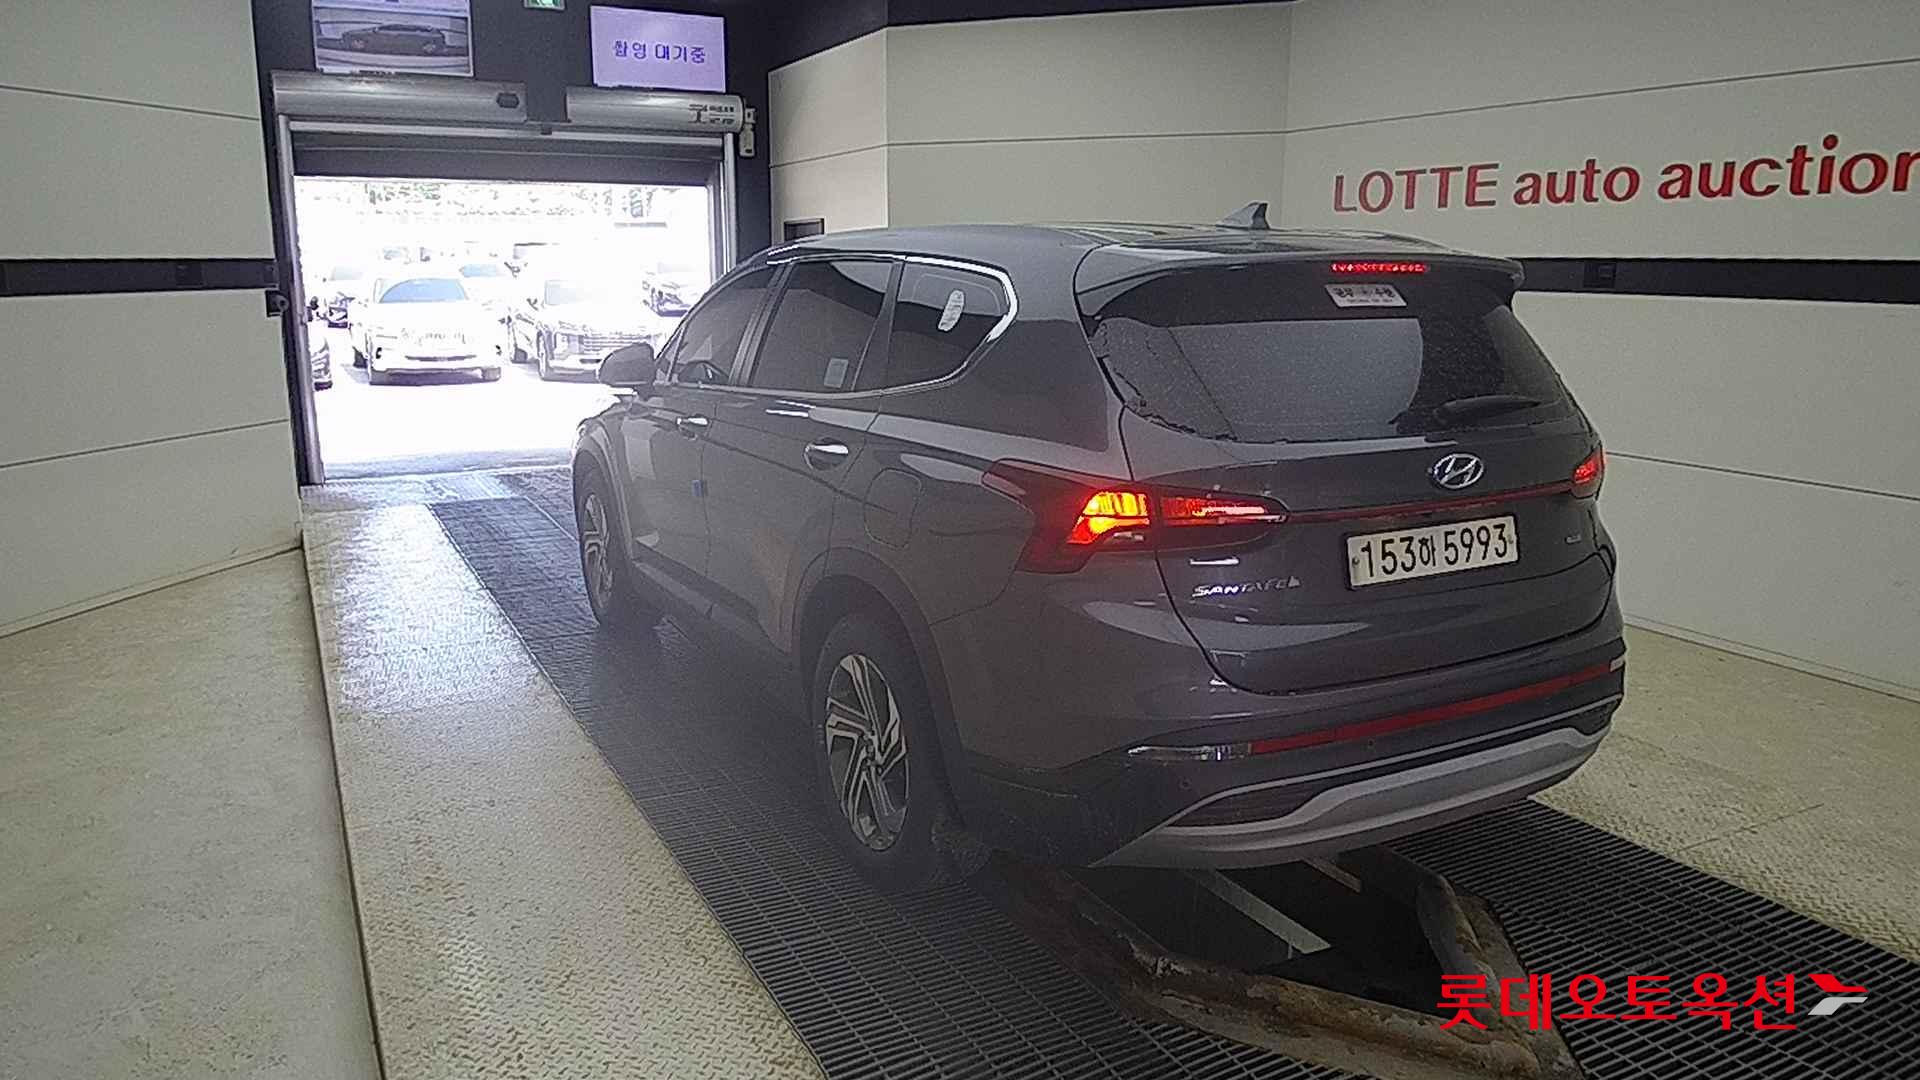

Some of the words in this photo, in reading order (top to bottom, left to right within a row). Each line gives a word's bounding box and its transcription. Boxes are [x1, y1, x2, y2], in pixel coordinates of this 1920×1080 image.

[654, 43, 706, 64] 대기중
[1334, 163, 1500, 213] LOTTE
[1513, 158, 1641, 205] auto
